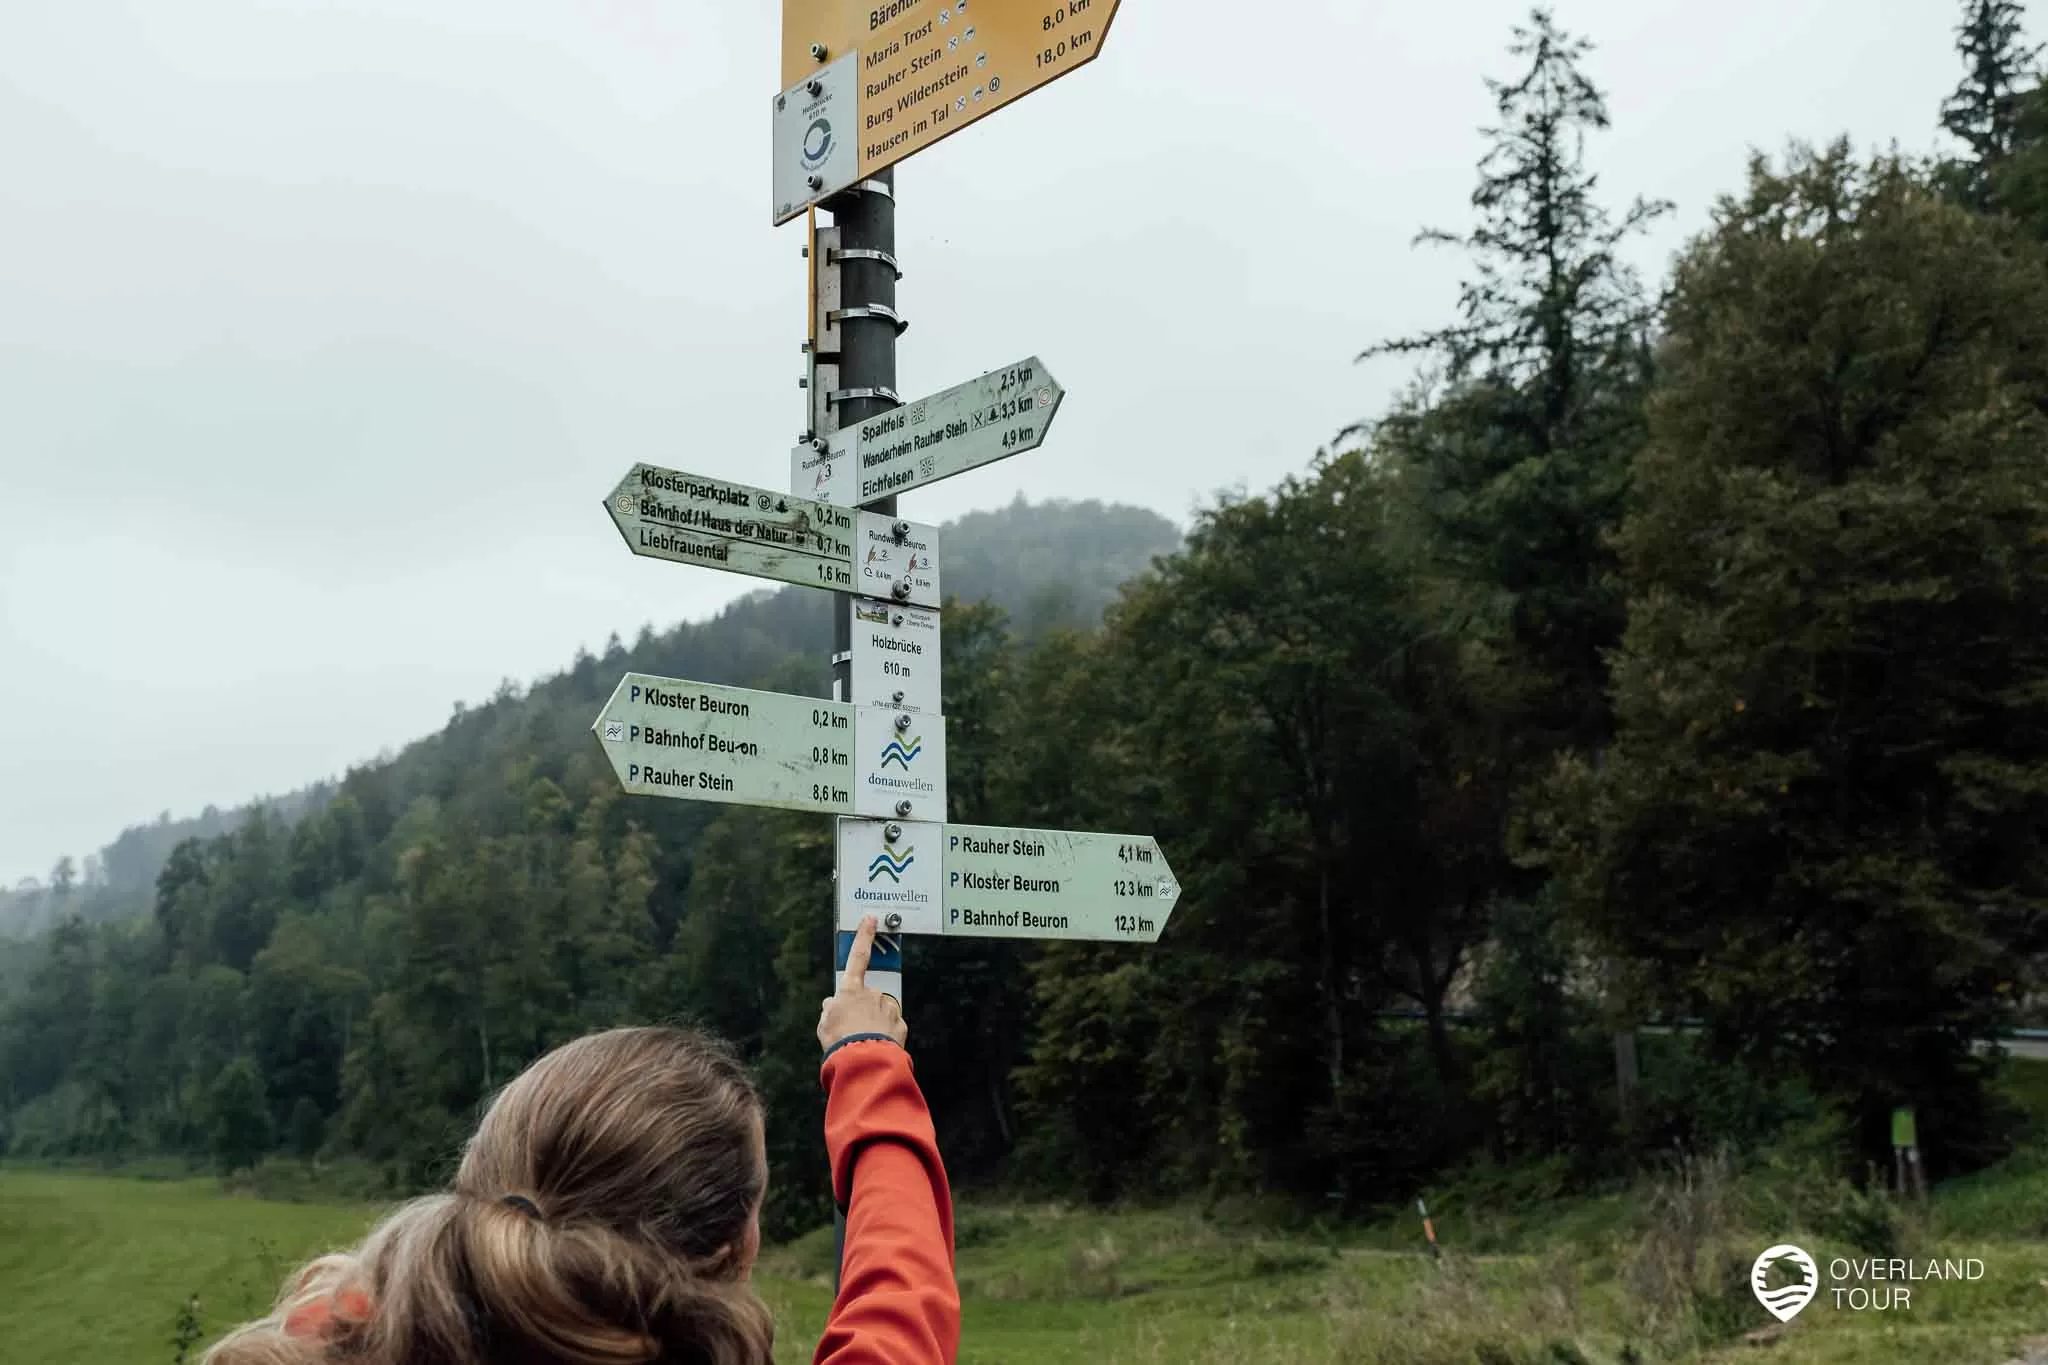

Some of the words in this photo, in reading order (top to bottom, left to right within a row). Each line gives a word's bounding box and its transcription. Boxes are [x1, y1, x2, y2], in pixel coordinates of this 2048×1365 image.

[865, 107, 893, 129] Burg
[897, 65, 968, 112] Wildenstein
[1043, 9, 1064, 31] 8,0
[1070, 0, 1090, 16] km
[866, 42, 900, 69] Maria
[904, 20, 932, 47] Trost
[866, 68, 907, 99] Rauher
[911, 48, 942, 74] Stein
[867, 130, 908, 160] Hausen
[913, 119, 928, 136] im
[931, 104, 949, 125] Tal
[1036, 42, 1065, 68] 18,0
[1070, 30, 1092, 50] km
[862, 414, 905, 443] Spaltfels
[1001, 370, 1016, 392] 2,5
[1018, 367, 1033, 384] km
[863, 440, 912, 468] Wanderheim
[914, 429, 944, 451] Rauher
[945, 419, 967, 439] Stein
[1001, 400, 1016, 420] 3,3
[1018, 397, 1033, 414] km
[825, 463, 832, 478] 3
[862, 469, 914, 497] Eichfelsen
[1002, 429, 1017, 449] 4,9
[1019, 427, 1033, 443] km
[641, 468, 749, 507] Klosterparkplatz
[817, 507, 832, 527] 0,2
[835, 511, 850, 529] km
[641, 499, 692, 524] Bahnhof
[702, 511, 731, 533] Haus
[735, 520, 755, 537] der
[757, 523, 788, 543] Natur
[817, 535, 832, 554] 0,7
[835, 538, 851, 557] km
[904, 538, 927, 551] Beuron
[640, 528, 728, 561] Liebfrauental
[818, 564, 833, 582] 1,6
[836, 567, 851, 585] km
[872, 634, 921, 655] Holzbrücke
[884, 661, 900, 675] 610
[902, 666, 911, 677] m
[631, 685, 640, 702] P
[645, 687, 696, 710] Kloster
[700, 695, 750, 717] Beuron
[813, 709, 829, 728] 0,2
[832, 712, 848, 728] km
[630, 725, 640, 742] P
[645, 727, 705, 750] Bahnhof
[813, 746, 829, 766] 0,8
[832, 748, 848, 766] km
[629, 764, 639, 781] P
[644, 766, 695, 787] Rauher
[699, 772, 734, 791] Stein
[813, 784, 829, 804] 8,6
[832, 786, 848, 803] km
[868, 773, 933, 792] donauwellen
[950, 836, 959, 852] P
[963, 837, 1010, 854] Rauher
[1013, 839, 1045, 856] Stein
[1118, 844, 1133, 863] 4,1
[1136, 846, 1152, 863] km
[854, 888, 929, 903] donauwellen
[951, 872, 960, 888] P
[963, 873, 1010, 890] Kloster
[1013, 875, 1060, 893] Beuron
[1138, 880, 1153, 897] km
[951, 909, 960, 925] P
[963, 909, 1019, 927] Bahnhof
[1022, 911, 1069, 929] Beuron
[1114, 916, 1136, 934] 12,3
[1138, 916, 1154, 932] km
